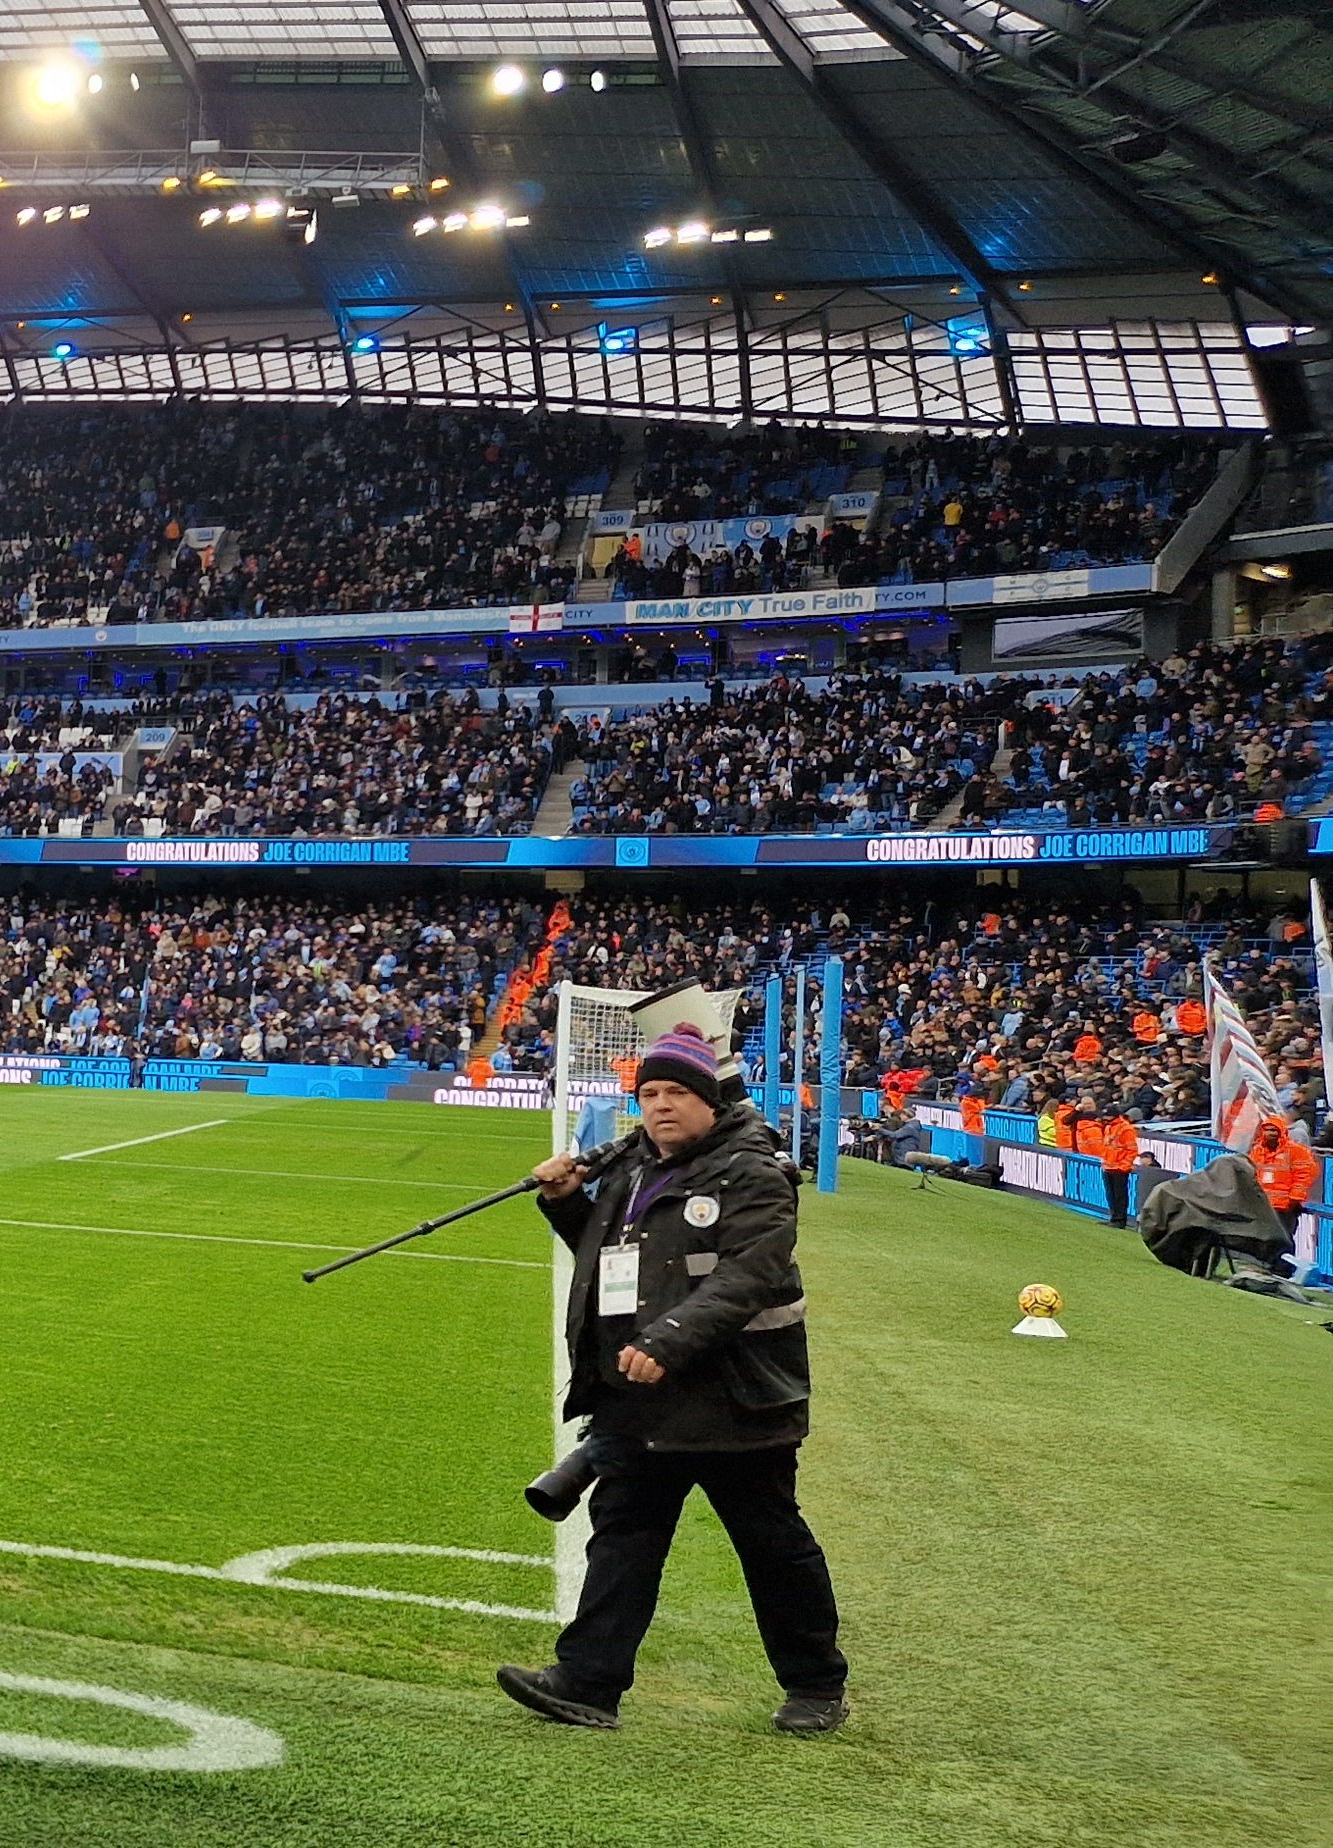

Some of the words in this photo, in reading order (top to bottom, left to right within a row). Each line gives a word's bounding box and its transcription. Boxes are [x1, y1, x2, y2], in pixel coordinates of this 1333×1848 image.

[842, 497, 865, 509] 310
[602, 516, 624, 527] 309
[565, 609, 593, 619] CITY
[635, 602, 690, 619] MAN
[696, 599, 755, 617] CITY
[760, 597, 805, 613] True
[811, 592, 863, 610] Faith
[182, 622, 206, 633] The
[209, 621, 243, 632] ONLY
[397, 612, 430, 623] from
[433, 608, 509, 621] Mancheste
[145, 733, 165, 742] 209
[126, 842, 259, 862] CONGRATULATIONS
[263, 842, 292, 862] JOE
[293, 842, 372, 862] CORRIGAN
[373, 842, 410, 862] MBE
[866, 835, 1034, 861] CONGRATULATIONS
[1039, 834, 1074, 859] JOE
[1076, 831, 1168, 857] CORRIGAN
[72, 1073, 157, 1091] CORRIGN
